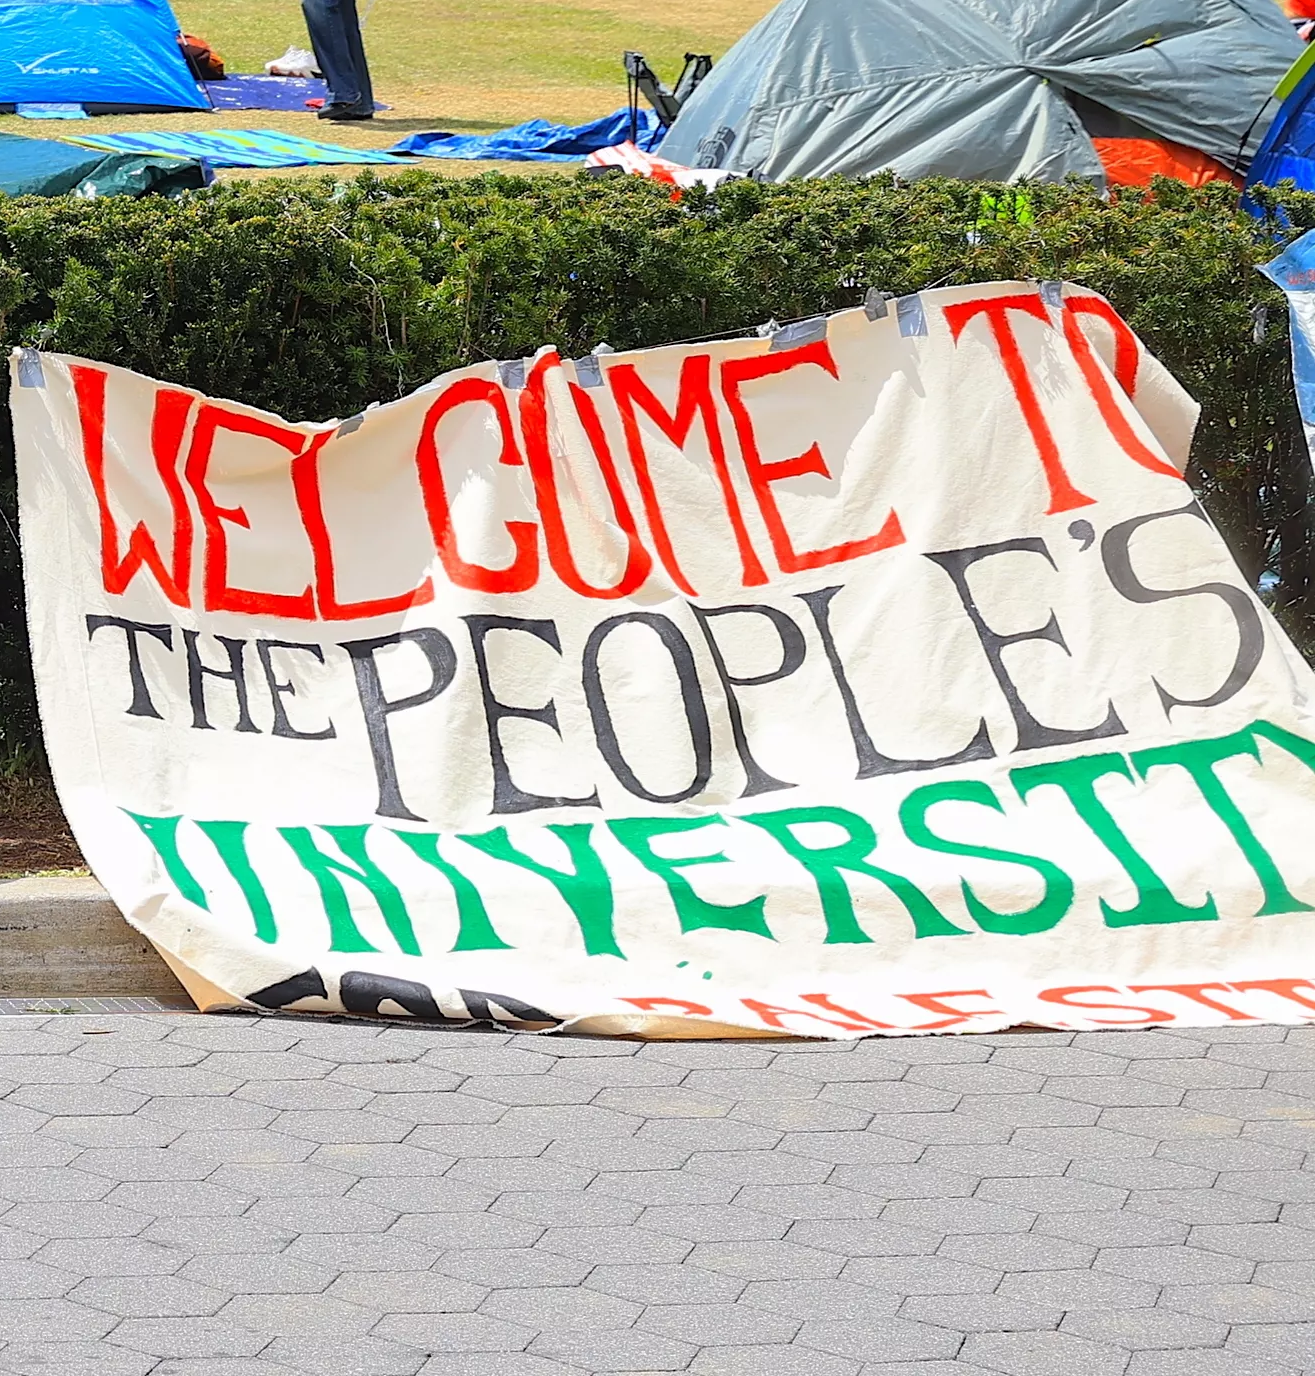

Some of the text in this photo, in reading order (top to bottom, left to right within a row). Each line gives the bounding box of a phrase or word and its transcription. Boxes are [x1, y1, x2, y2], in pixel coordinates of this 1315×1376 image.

[70, 294, 1186, 622] WELCOME TO
[86, 501, 1266, 822] THE PEOPLE'S
